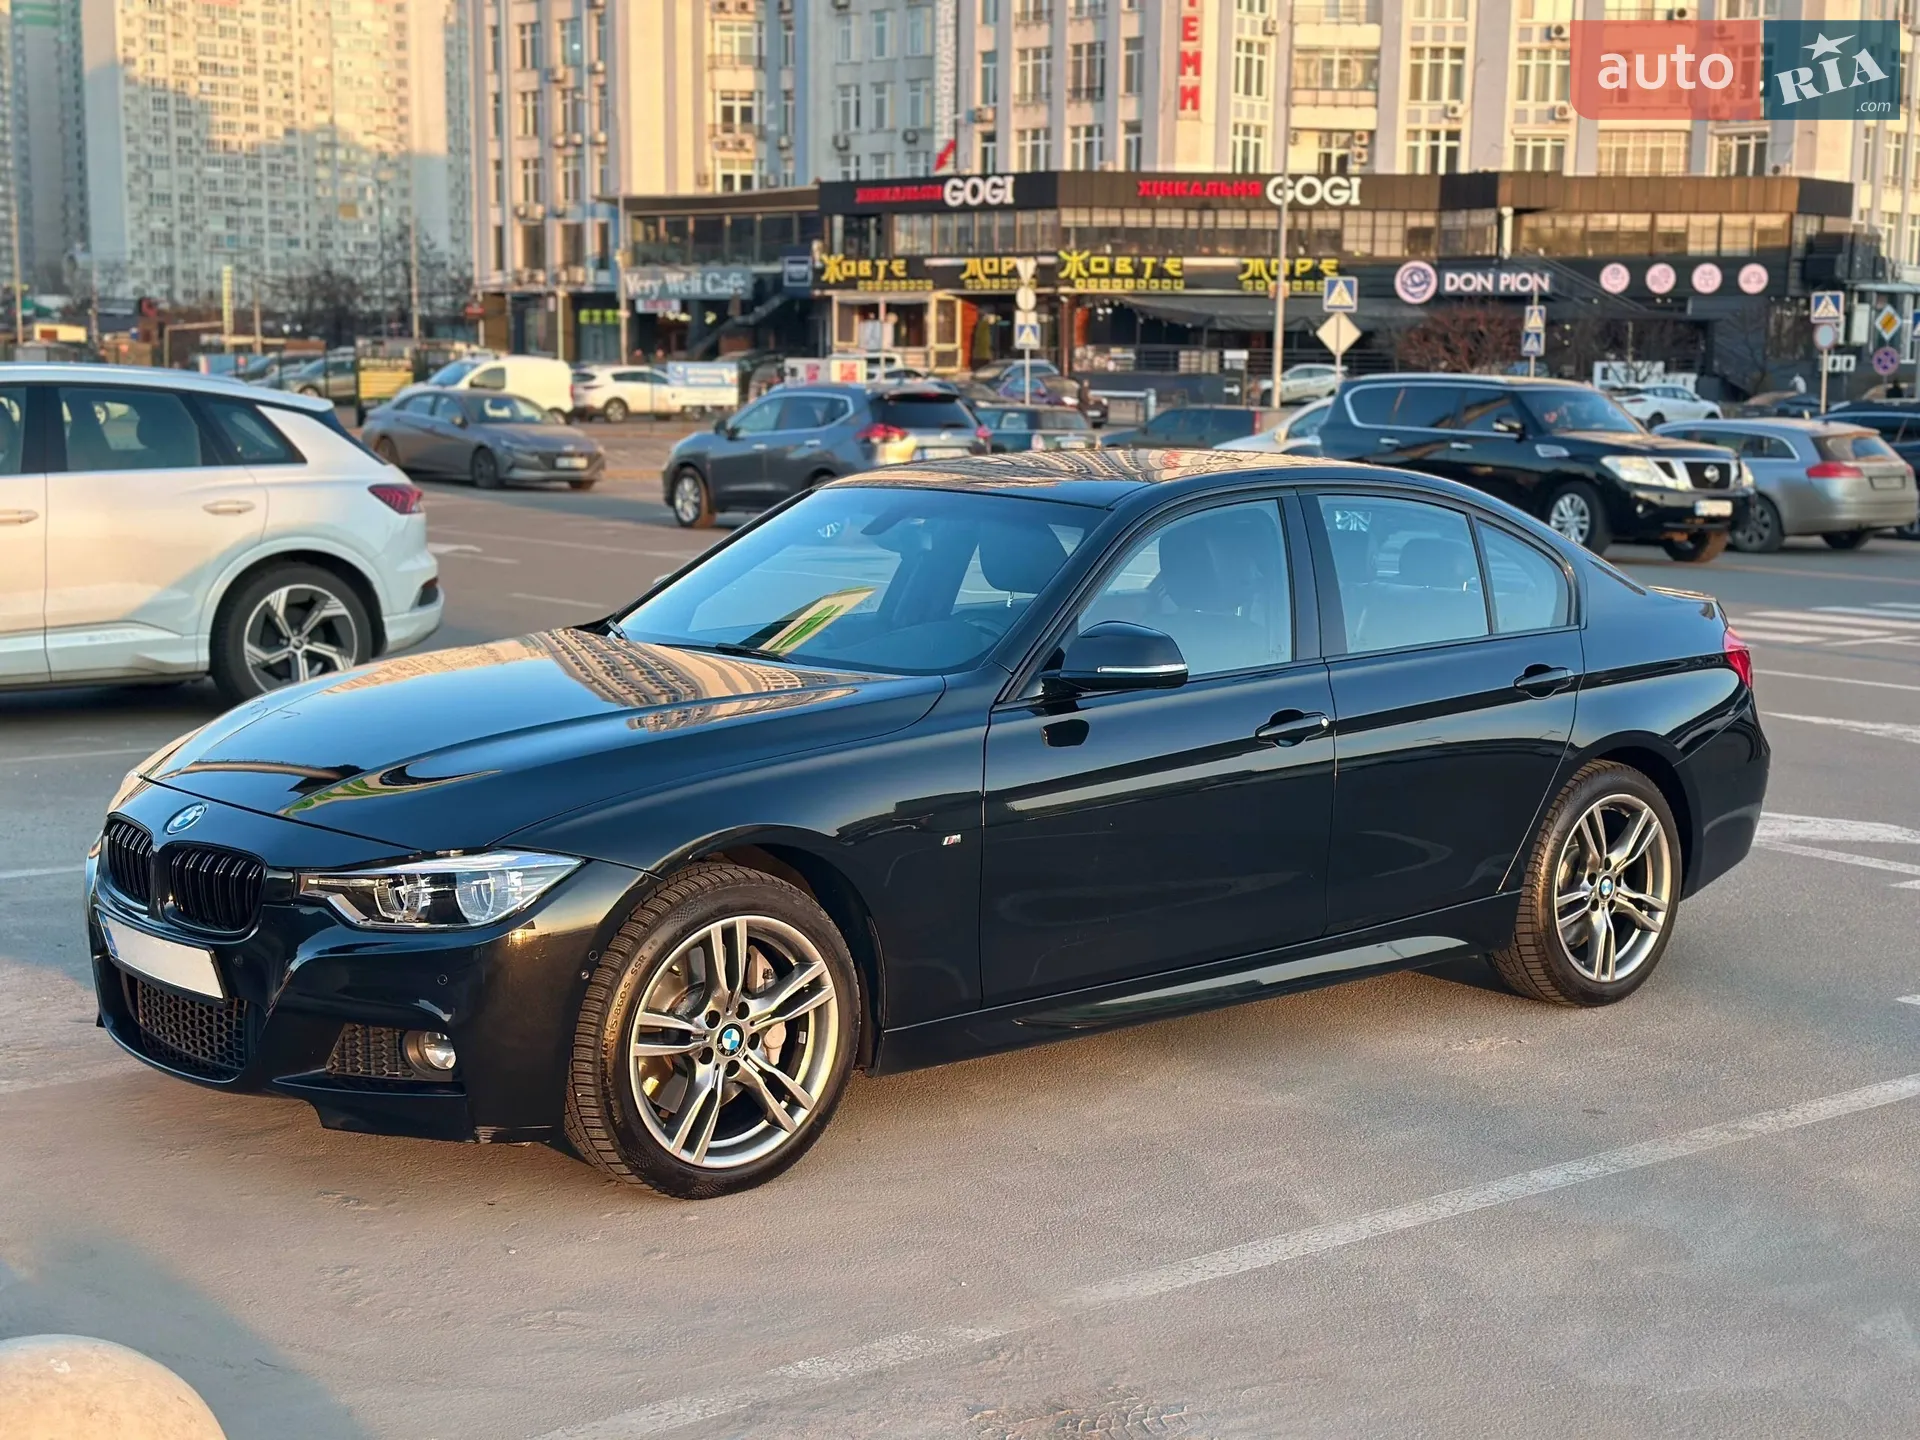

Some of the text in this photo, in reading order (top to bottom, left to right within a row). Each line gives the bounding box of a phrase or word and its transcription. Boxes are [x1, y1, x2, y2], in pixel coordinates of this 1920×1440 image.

[943, 175, 1015, 206] GOGI
[1138, 175, 1362, 205] ХІНКАЛЬНЯ GOGI
[960, 257, 1026, 281] МОР
[1444, 272, 1550, 293] DON PION
